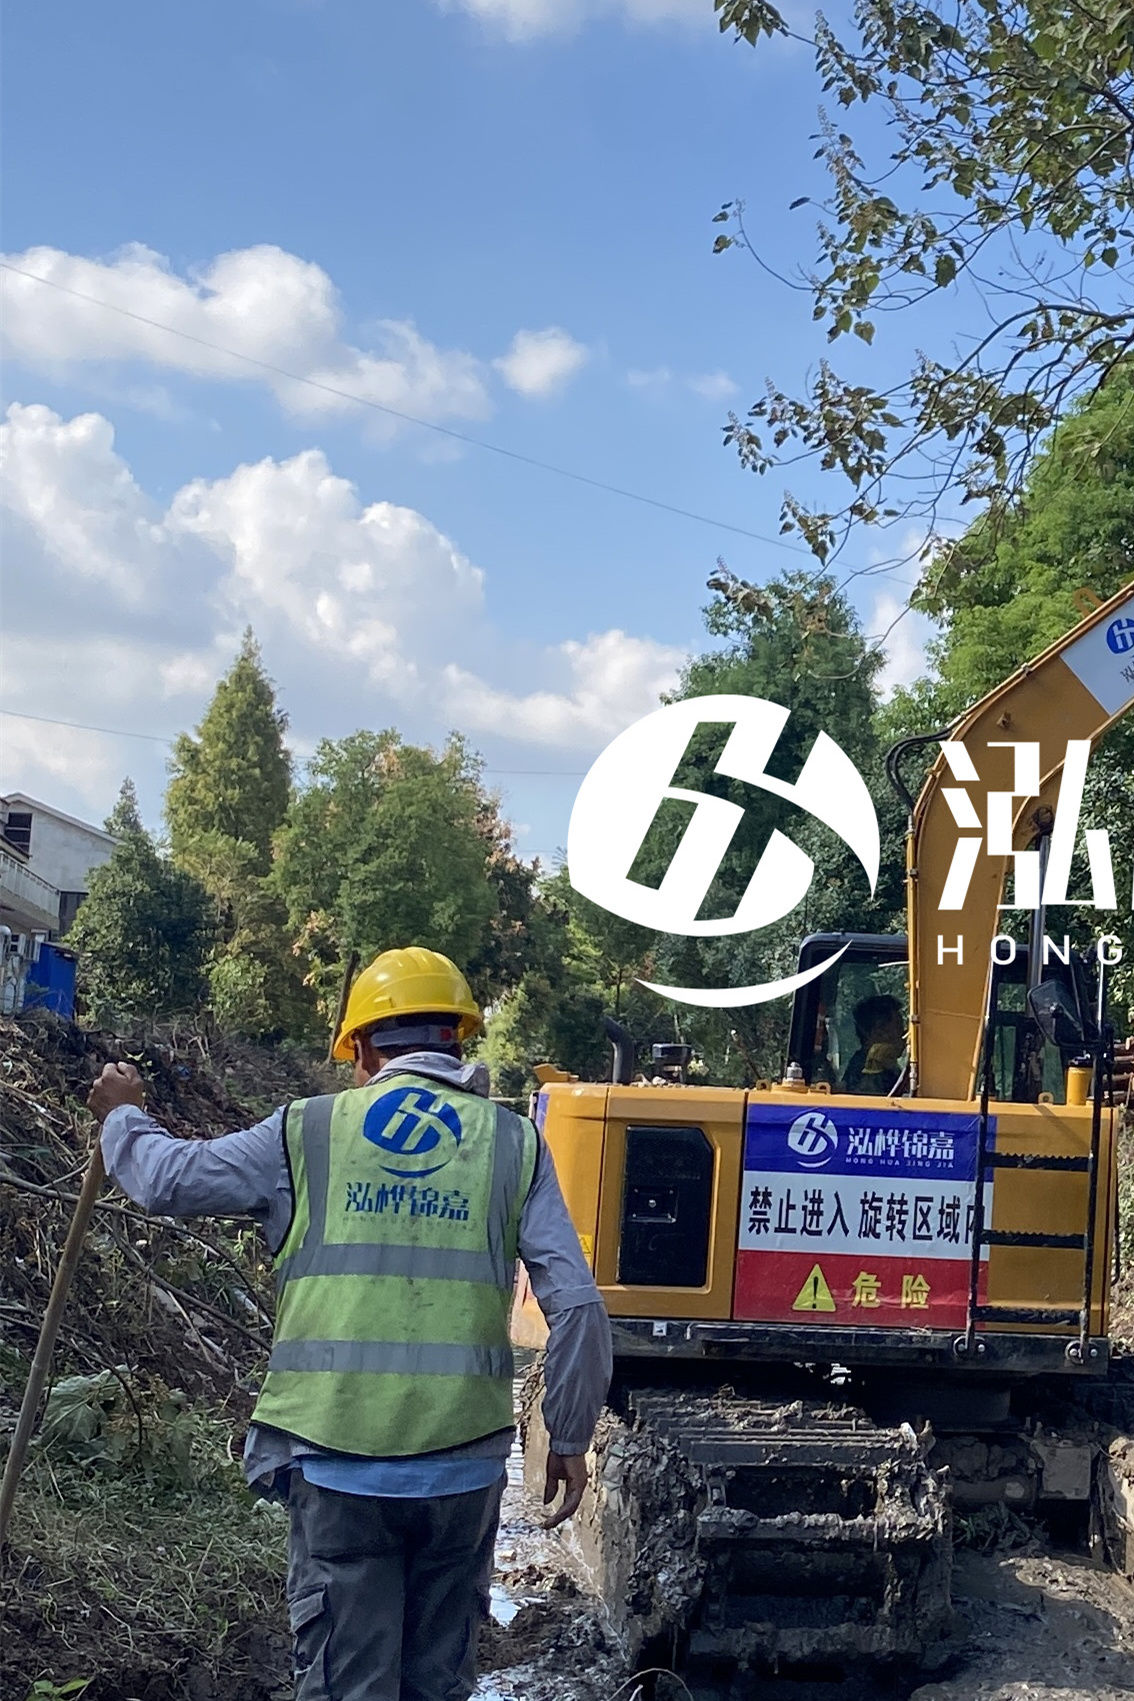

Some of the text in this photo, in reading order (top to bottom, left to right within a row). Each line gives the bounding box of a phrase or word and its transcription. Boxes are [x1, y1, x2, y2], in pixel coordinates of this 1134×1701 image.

[847, 1127, 954, 1160] 泓桦锦嘉
[845, 1157, 954, 1168] HONG HUA JING JIA
[748, 1186, 849, 1237] 禁止进入
[852, 1271, 931, 1309] 危险
